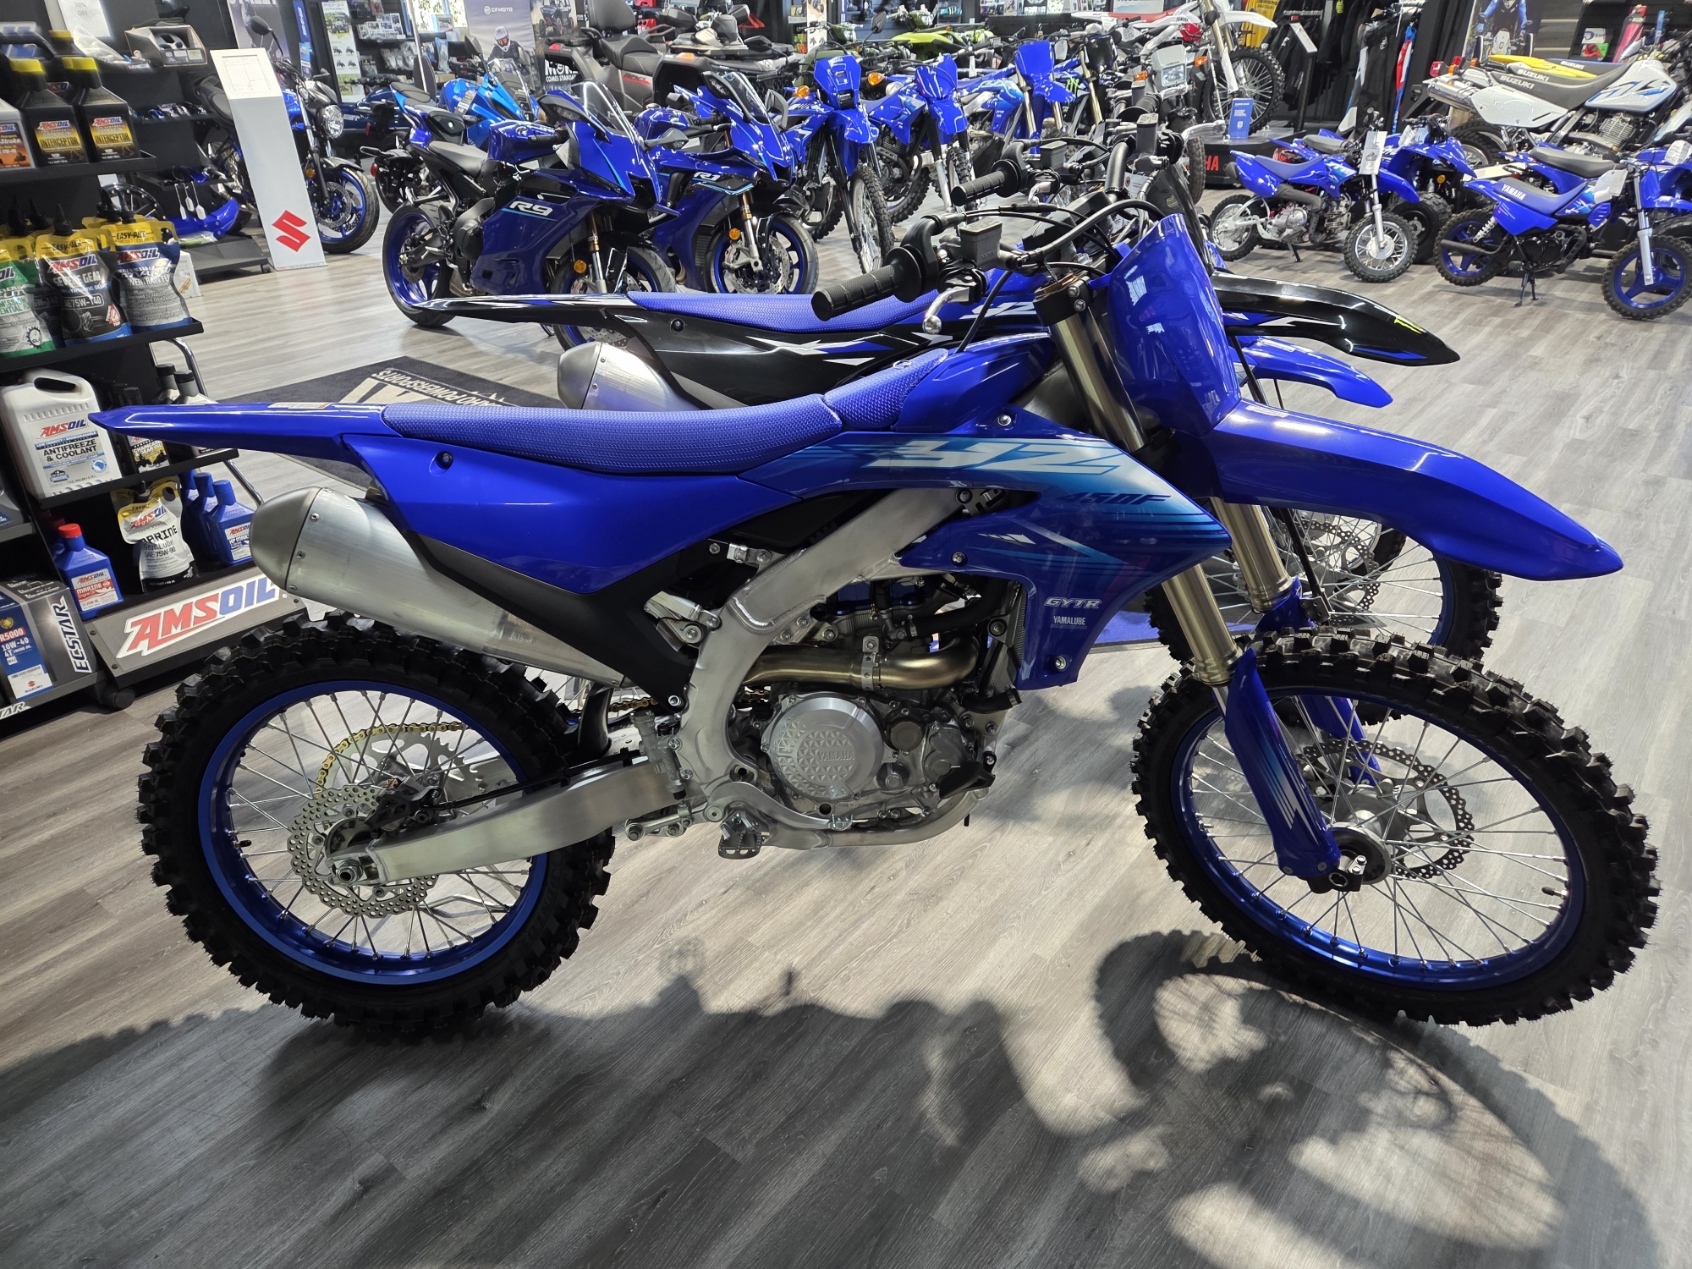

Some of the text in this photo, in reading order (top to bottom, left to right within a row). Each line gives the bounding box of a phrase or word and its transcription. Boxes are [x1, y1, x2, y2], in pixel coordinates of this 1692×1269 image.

[1560, 60, 1585, 70] SUZUKI
[1499, 75, 1535, 90] SUZUKI
[1516, 69, 1550, 82] SUZUKI
[39, 121, 70, 130] AMSOIL
[93, 117, 122, 126] AMSOIL
[1500, 184, 1526, 201] YAMAHA
[510, 201, 553, 216] R9
[49, 254, 98, 272] AMSOIL
[371, 369, 460, 401] POWERSPORTS
[40, 419, 87, 437] AMSOIL
[43, 438, 97, 456] ANTIFREEZE
[55, 445, 97, 460] COOLANT
[861, 439, 1120, 475] YZ
[77, 583, 102, 594] MARINE
[1044, 597, 1102, 609] GYTR
[123, 577, 278, 655] AMSOIL
[1053, 616, 1087, 626] YAMALUBE
[52, 596, 90, 673] ECSTAR
[1, 637, 30, 651] 10W-40
[0, 702, 26, 718] TAR
[820, 750, 855, 761] YAMAHA
